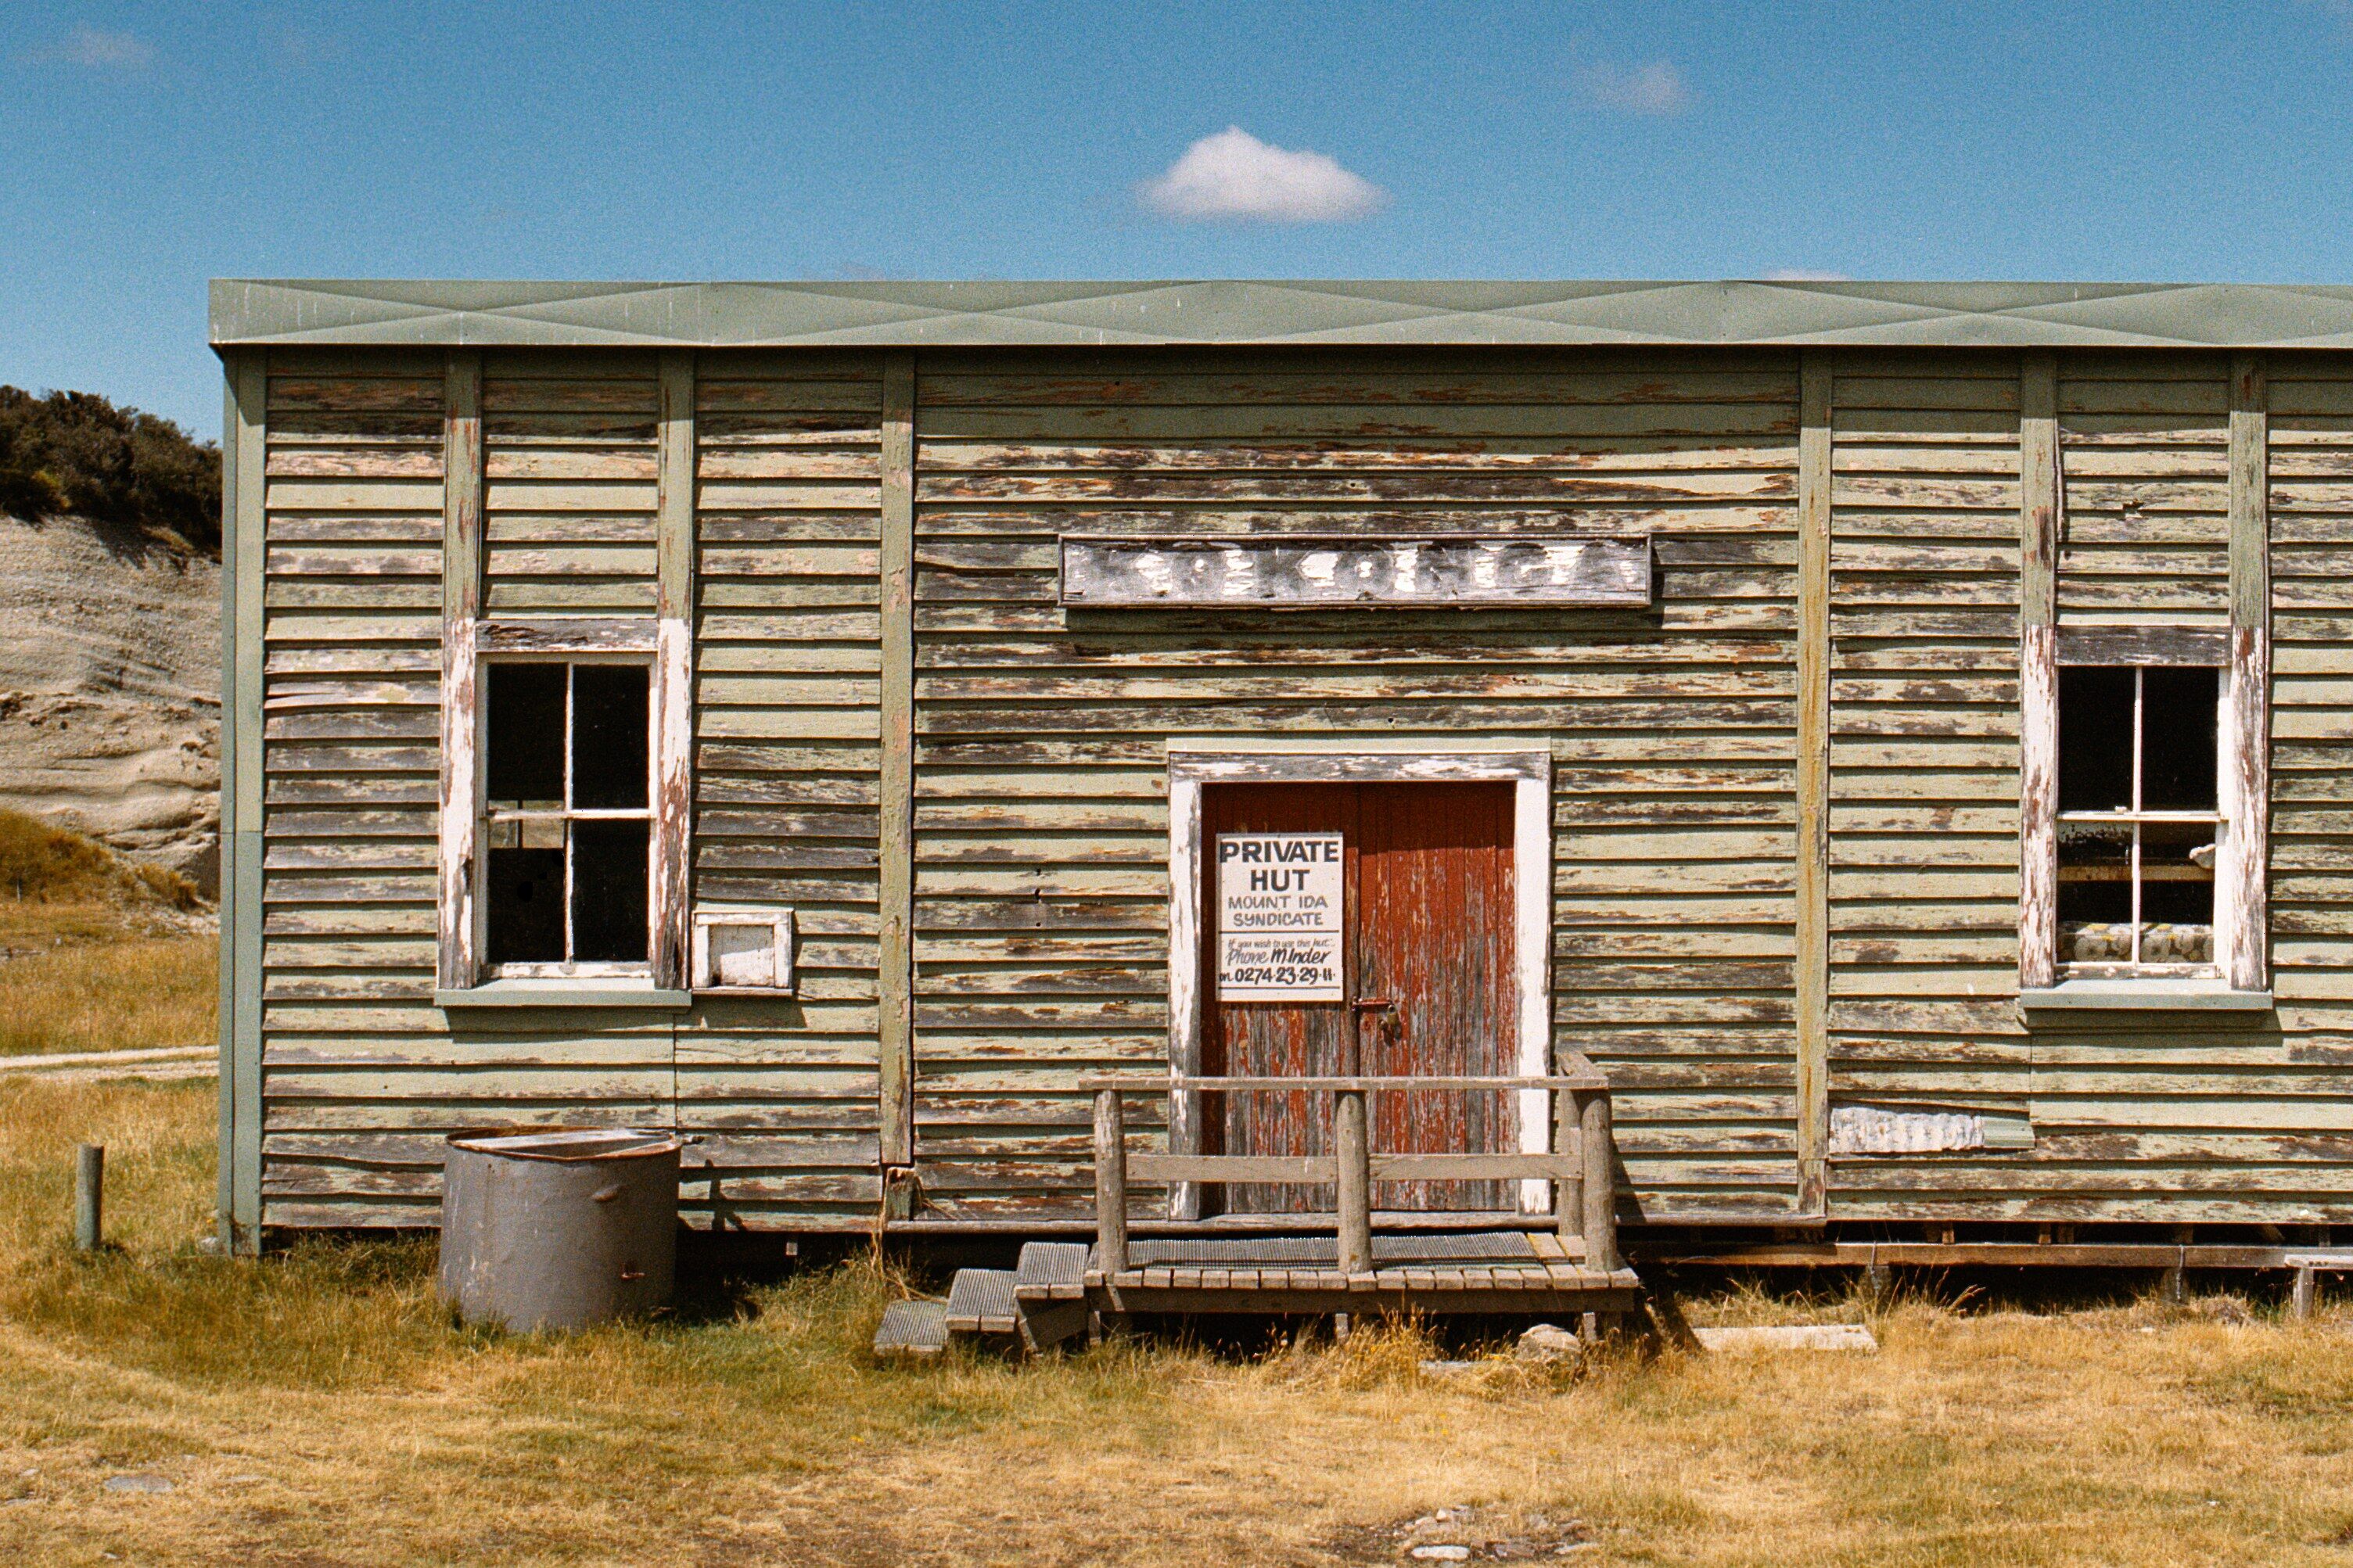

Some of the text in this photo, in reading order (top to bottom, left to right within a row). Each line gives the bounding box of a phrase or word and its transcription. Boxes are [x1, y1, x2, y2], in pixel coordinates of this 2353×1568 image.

[1220, 841, 1338, 863] PRIVATE
[1251, 869, 1310, 892] HUT
[1228, 895, 1328, 910] MOUNT IDA
[1234, 912, 1324, 926] SYNDICATE
[1225, 947, 1269, 967] Phone
